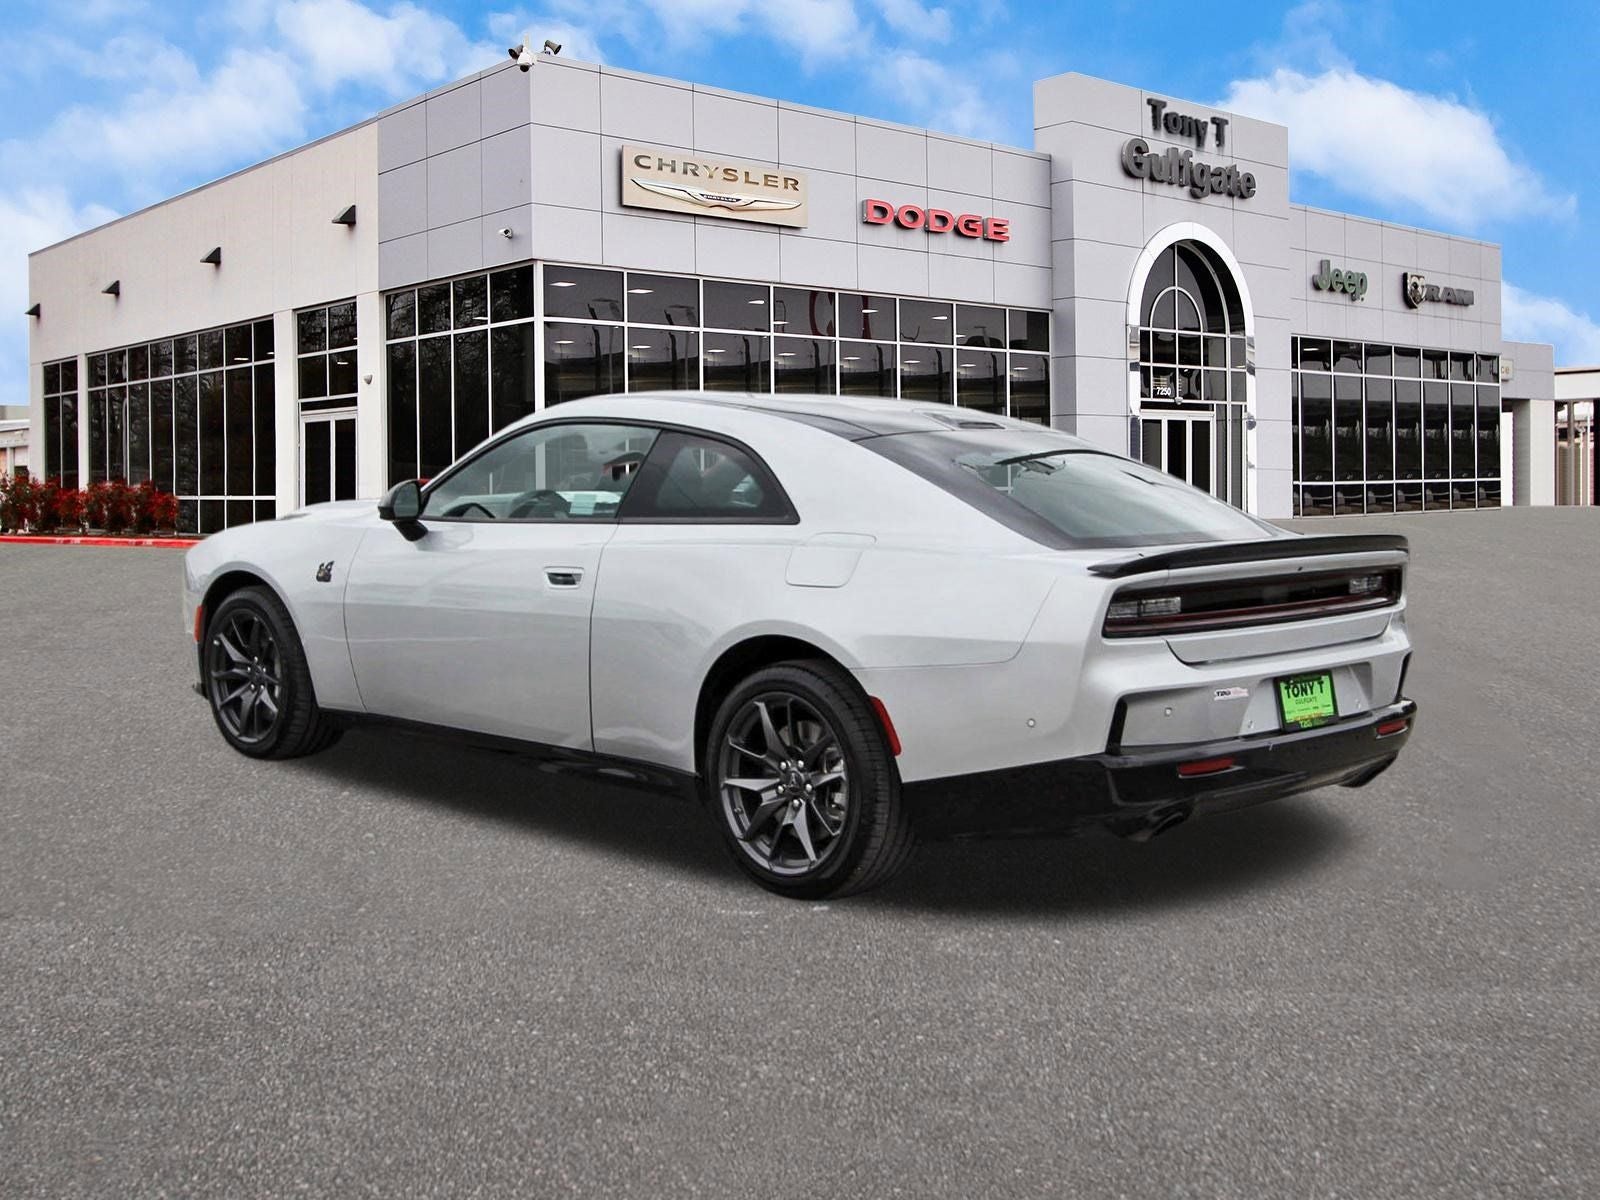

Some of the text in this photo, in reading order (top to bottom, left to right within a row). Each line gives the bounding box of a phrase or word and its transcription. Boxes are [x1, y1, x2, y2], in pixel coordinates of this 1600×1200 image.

[1146, 97, 1229, 148] Tony T
[633, 154, 800, 192] CHRYSLER
[1121, 137, 1257, 199] Gulfgate
[862, 198, 1010, 242] DODGE
[1312, 259, 1368, 302] Jeep
[1424, 283, 1475, 307] RAM
[1156, 386, 1172, 396] 7250
[1284, 680, 1325, 699] TONY T
